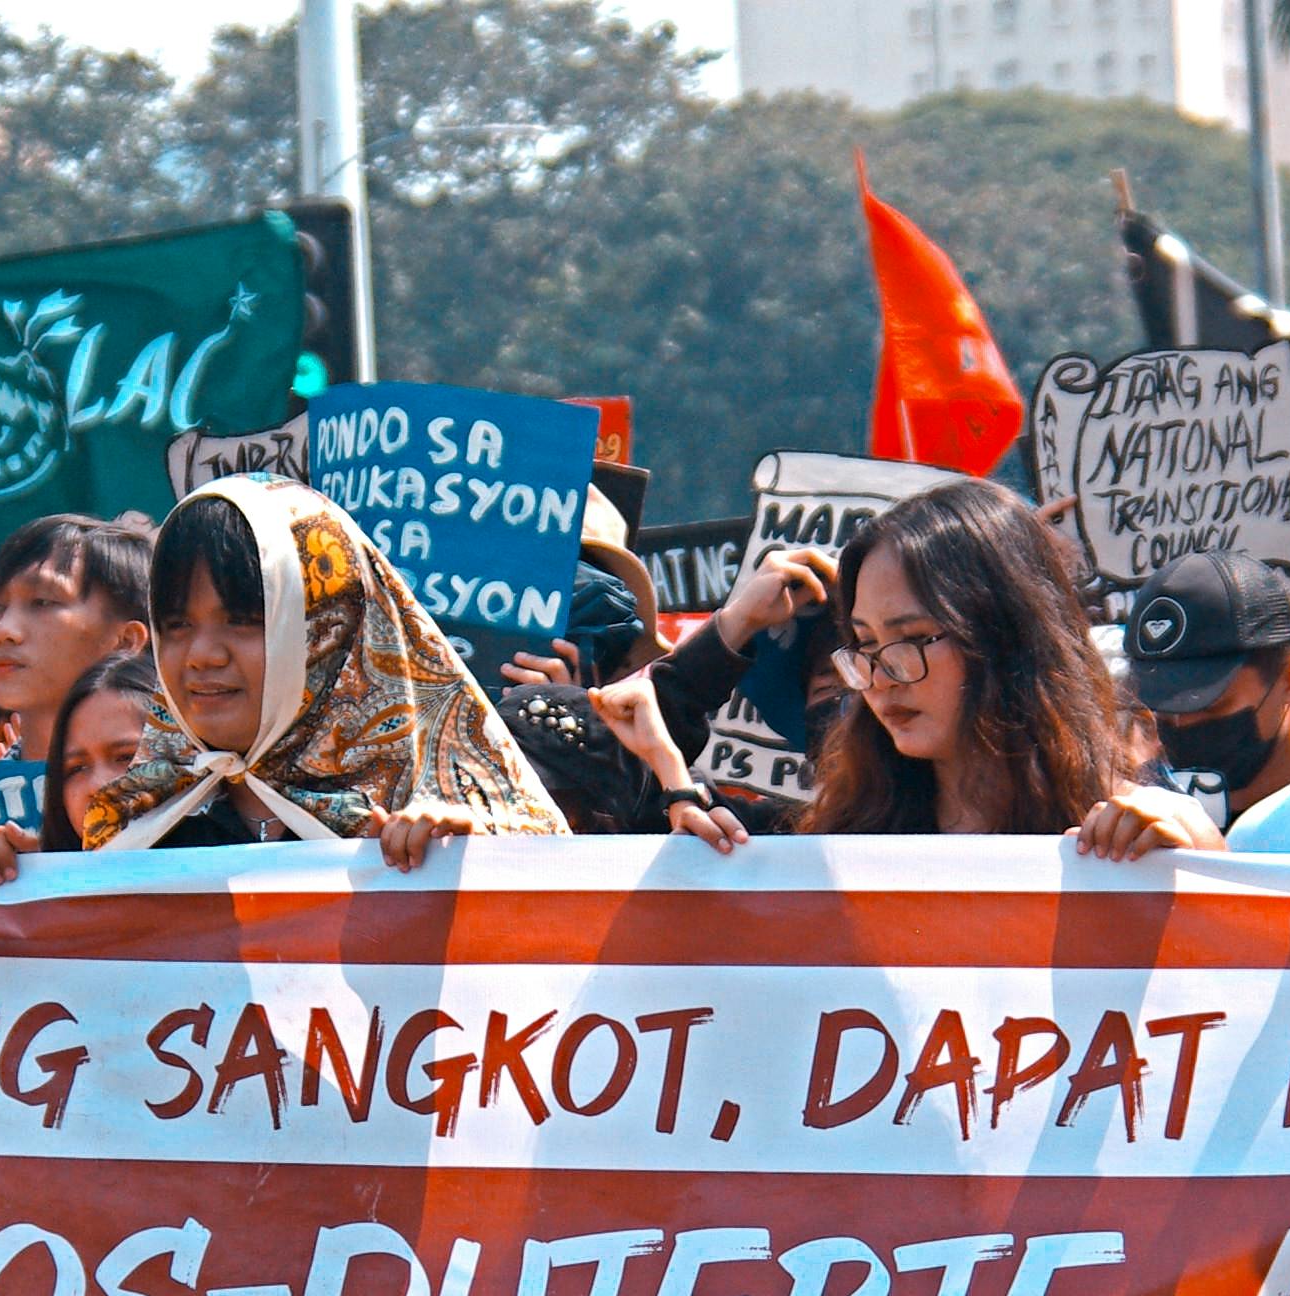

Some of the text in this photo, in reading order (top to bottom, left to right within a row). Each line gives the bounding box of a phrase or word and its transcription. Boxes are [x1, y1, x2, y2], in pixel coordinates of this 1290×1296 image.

[1214, 363, 1281, 407] ANG
[317, 406, 504, 469] PONDO SA
[1087, 409, 1290, 487] NATIONAL
[144, 1002, 741, 1143] SANGKOT,
[802, 1007, 1227, 1143] DAPAT
